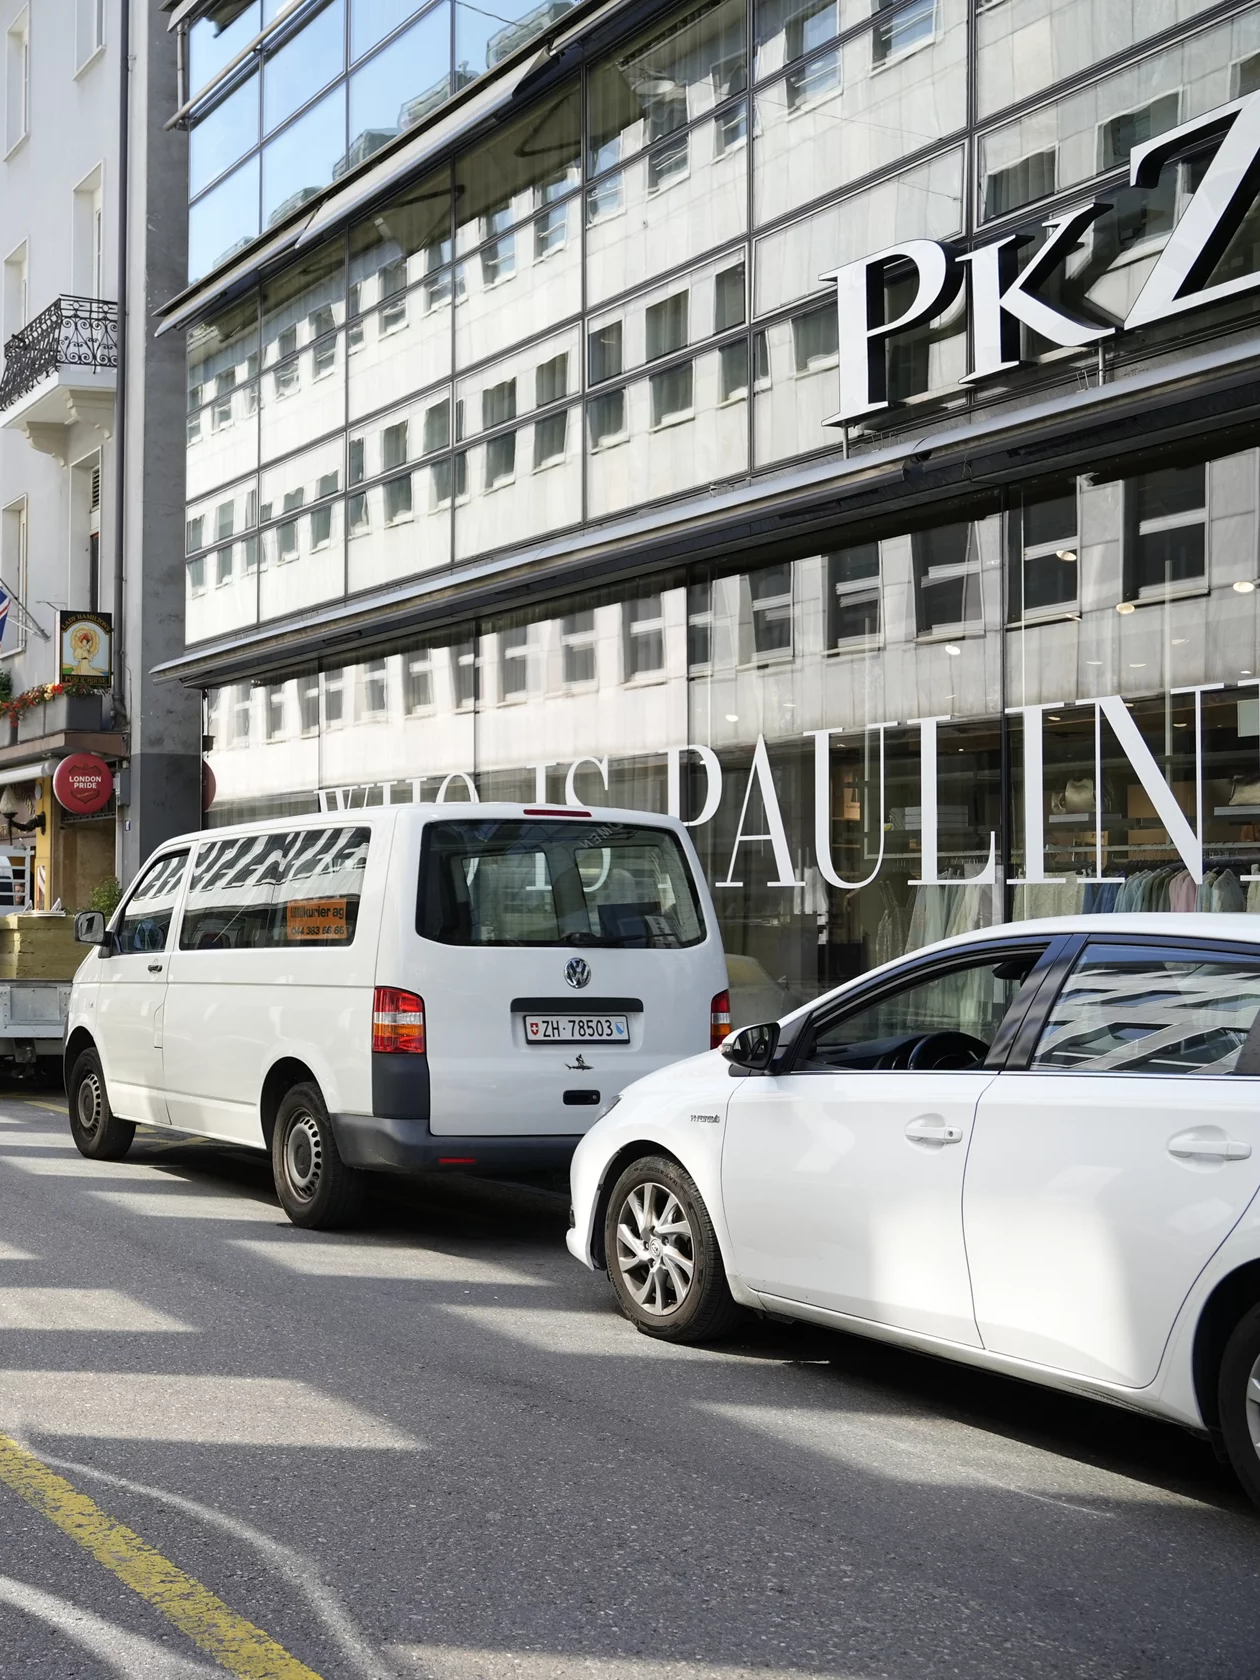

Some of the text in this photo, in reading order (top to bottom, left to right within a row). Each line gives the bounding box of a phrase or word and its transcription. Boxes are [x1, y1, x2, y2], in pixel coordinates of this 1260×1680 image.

[818, 88, 1260, 427] PKZ
[61, 615, 76, 629] LADY
[69, 775, 102, 783] LONDON
[659, 681, 1260, 890] PAULIN
[332, 907, 344, 919] ag
